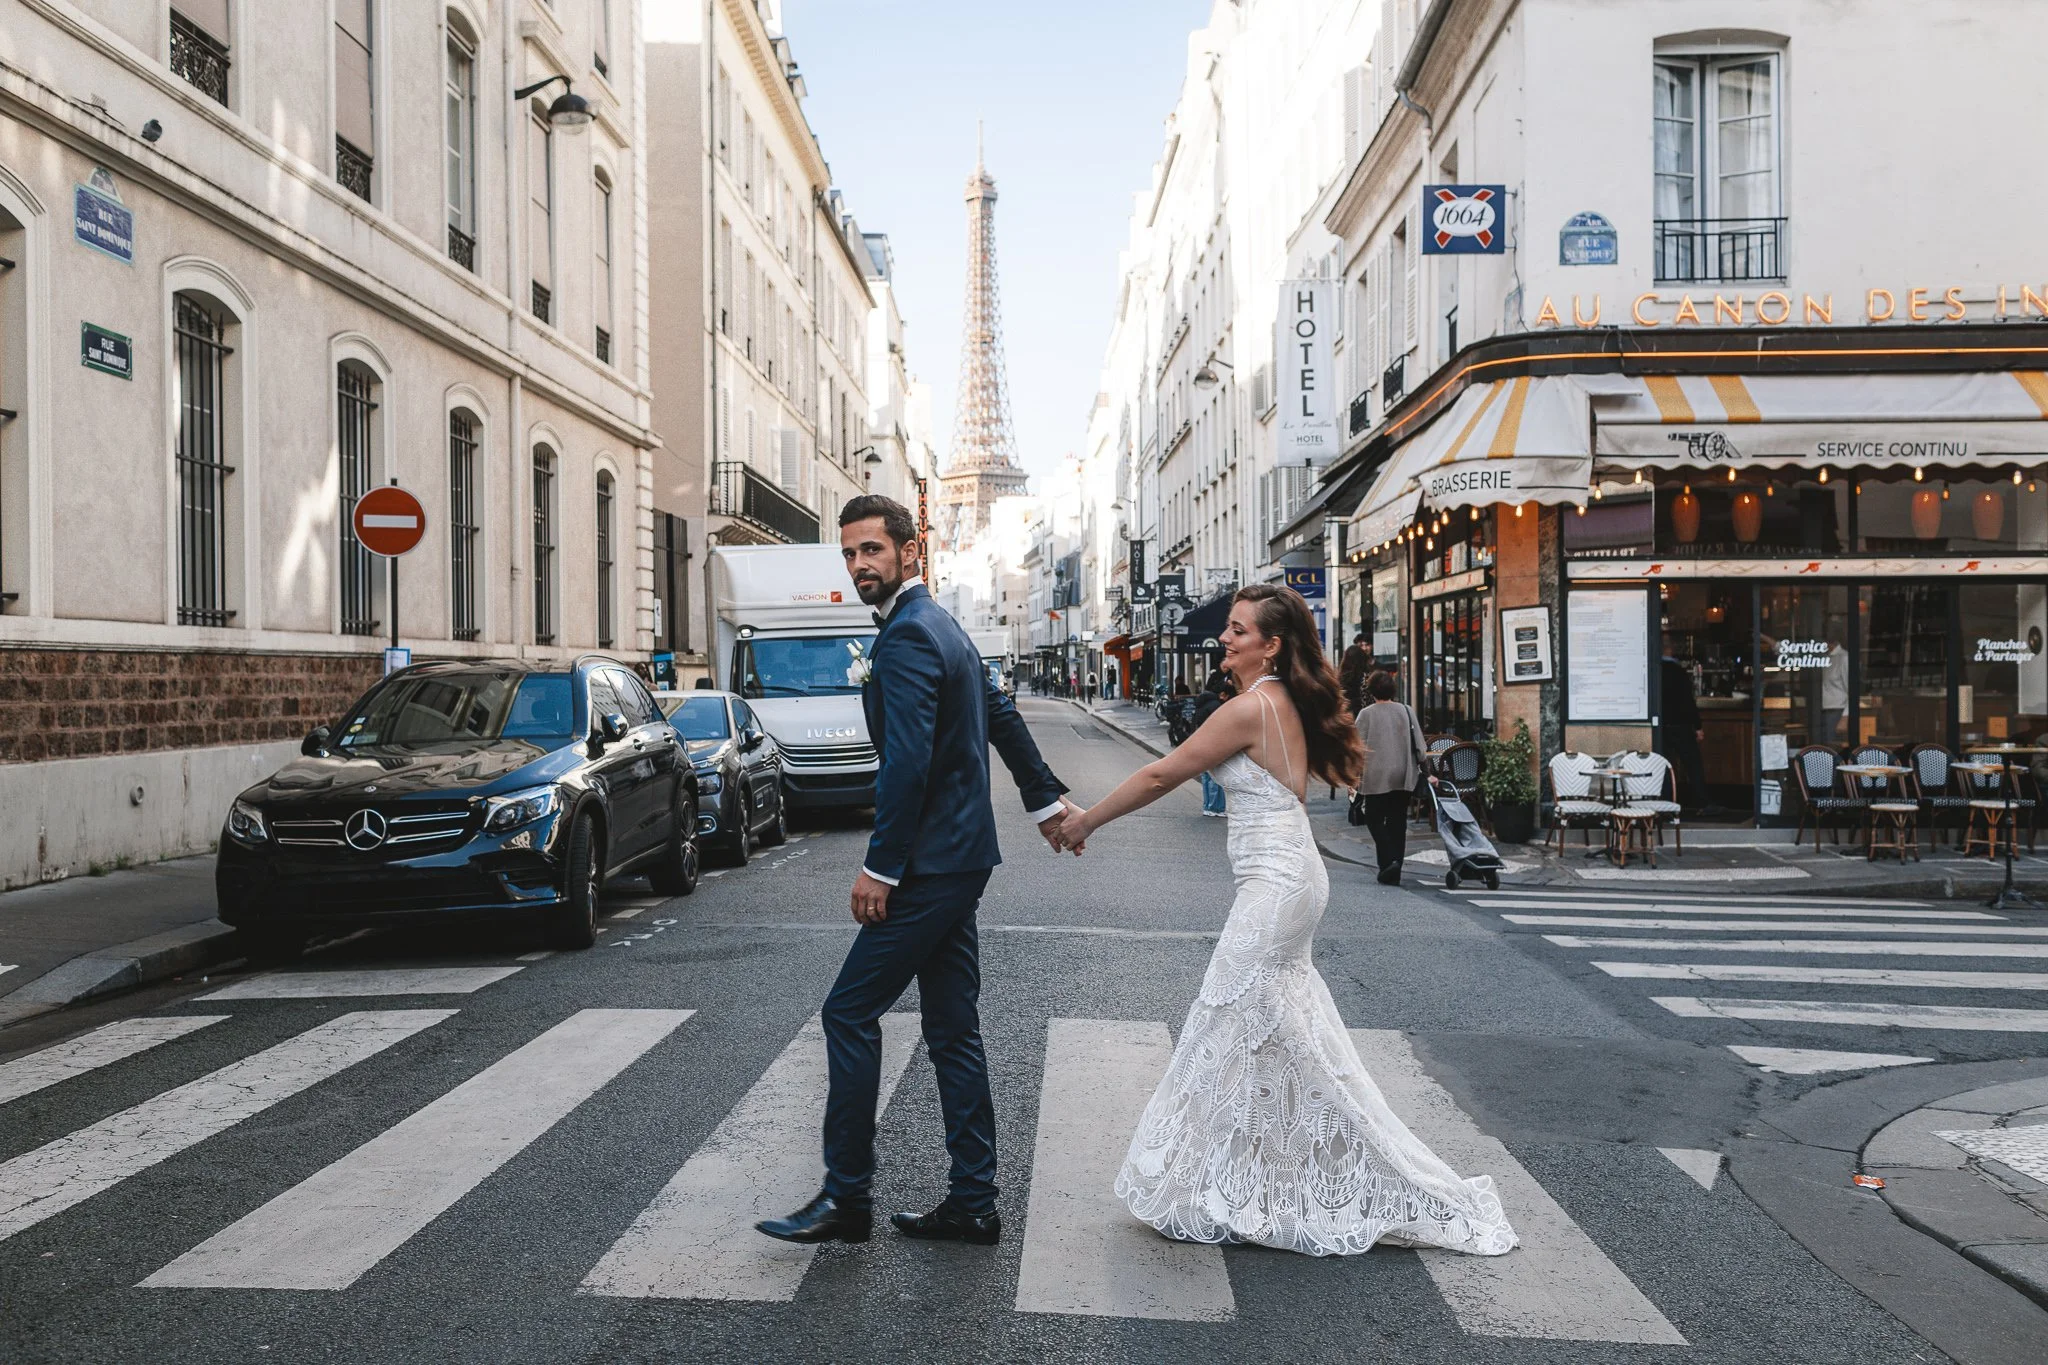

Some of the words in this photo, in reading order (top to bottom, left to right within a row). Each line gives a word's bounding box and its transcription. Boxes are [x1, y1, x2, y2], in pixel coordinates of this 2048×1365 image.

[98, 208, 114, 225] RUE
[1440, 203, 1489, 227] 1664
[76, 216, 97, 235] SAINT
[97, 226, 132, 251] DOMINIQUE
[1578, 238, 1600, 248] RUE
[1536, 294, 1602, 327] AU
[1632, 291, 1833, 327] CANON
[1867, 286, 1966, 321] DES
[101, 337, 115, 352] RUE
[89, 346, 102, 361] SAINT
[1296, 291, 1316, 417] HOTEL
[1296, 435, 1323, 443] HOTEL
[1817, 442, 1883, 457] SERVICE
[1889, 442, 1968, 457] CONTINU
[1432, 471, 1511, 497] BRASSERIE
[919, 480, 928, 585] THOUMIEU
[1287, 573, 1320, 584] LCL
[792, 593, 827, 601] VACHON
[1779, 639, 1828, 654] Service
[1977, 638, 2028, 650] Planches
[1777, 654, 1832, 668] Continu
[1974, 650, 1983, 661] à
[1984, 650, 2035, 664] Partager
[807, 727, 856, 738] IVECO
